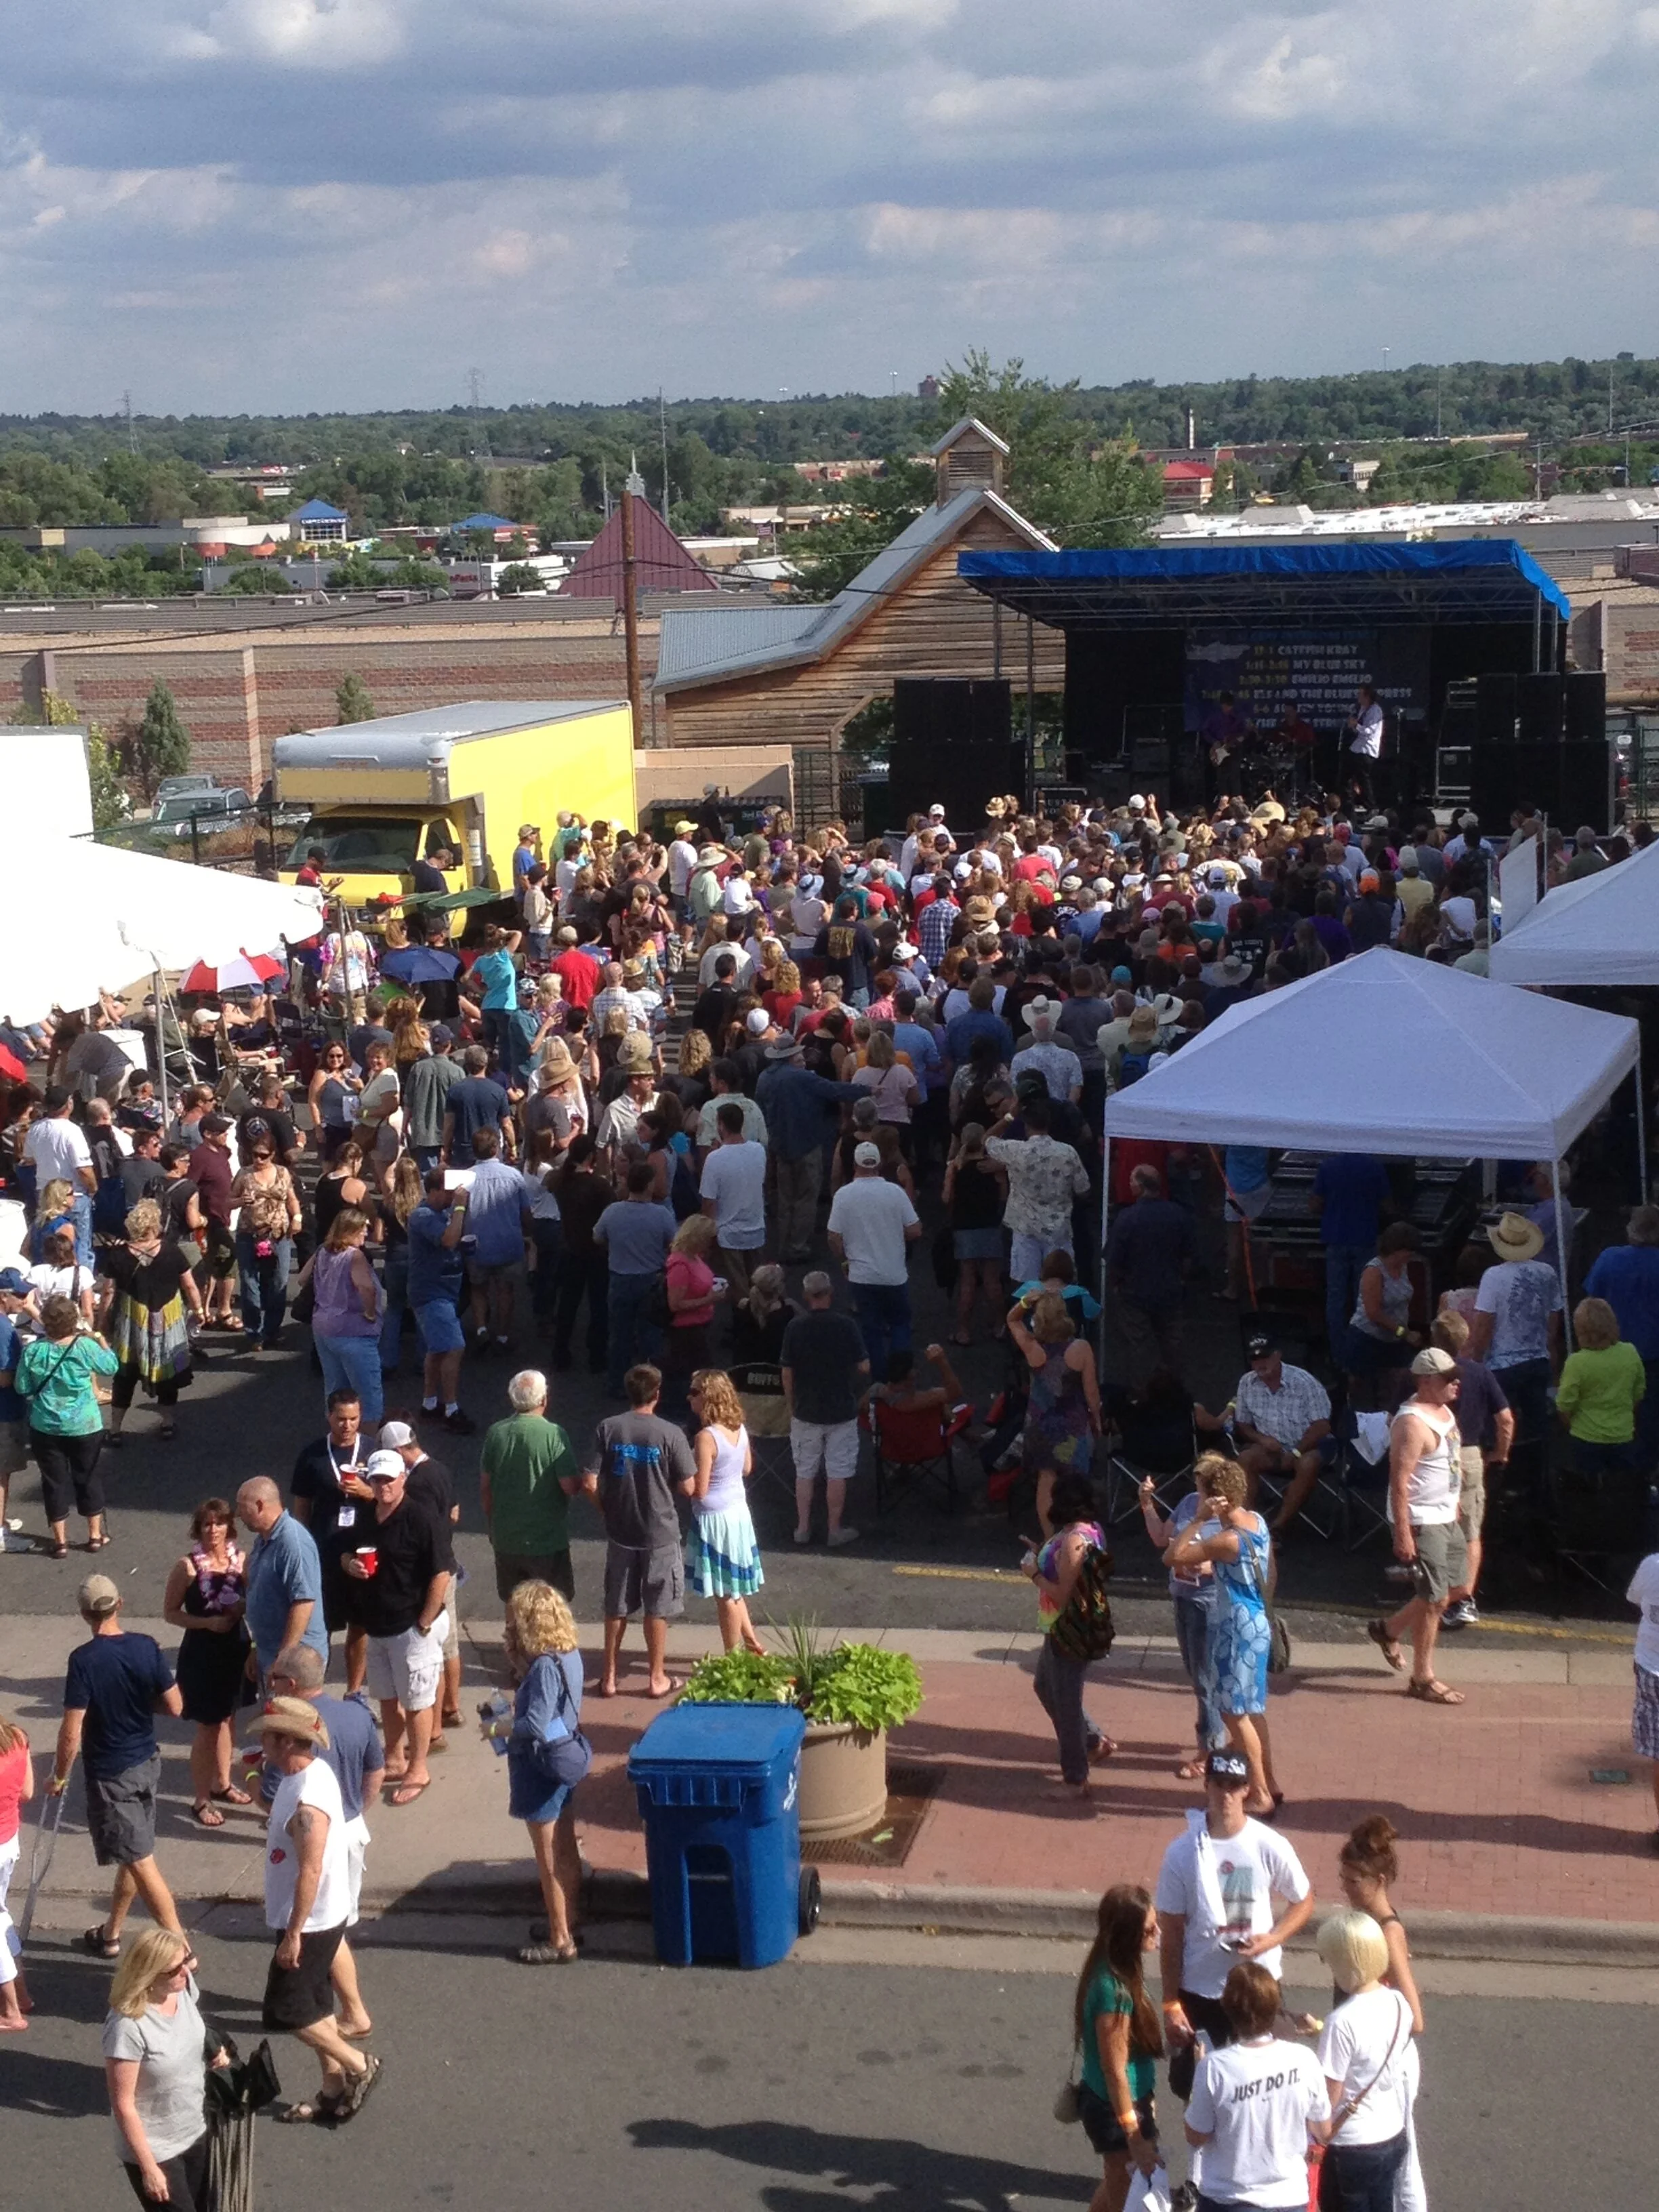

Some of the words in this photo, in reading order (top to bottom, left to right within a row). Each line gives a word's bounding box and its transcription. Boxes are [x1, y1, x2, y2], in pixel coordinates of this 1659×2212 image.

[1292, 659, 1311, 670] MY
[1313, 659, 1341, 670] BLUE
[1344, 659, 1366, 670] SKY
[1292, 674, 1330, 684] EMILIO
[1332, 674, 1373, 684] EMILIO
[1275, 689, 1298, 699] AND
[1300, 689, 1322, 699] THE
[1324, 689, 1359, 699] BLUES
[1231, 2078, 1263, 2104] JUST
[1265, 2072, 1284, 2092] DO
